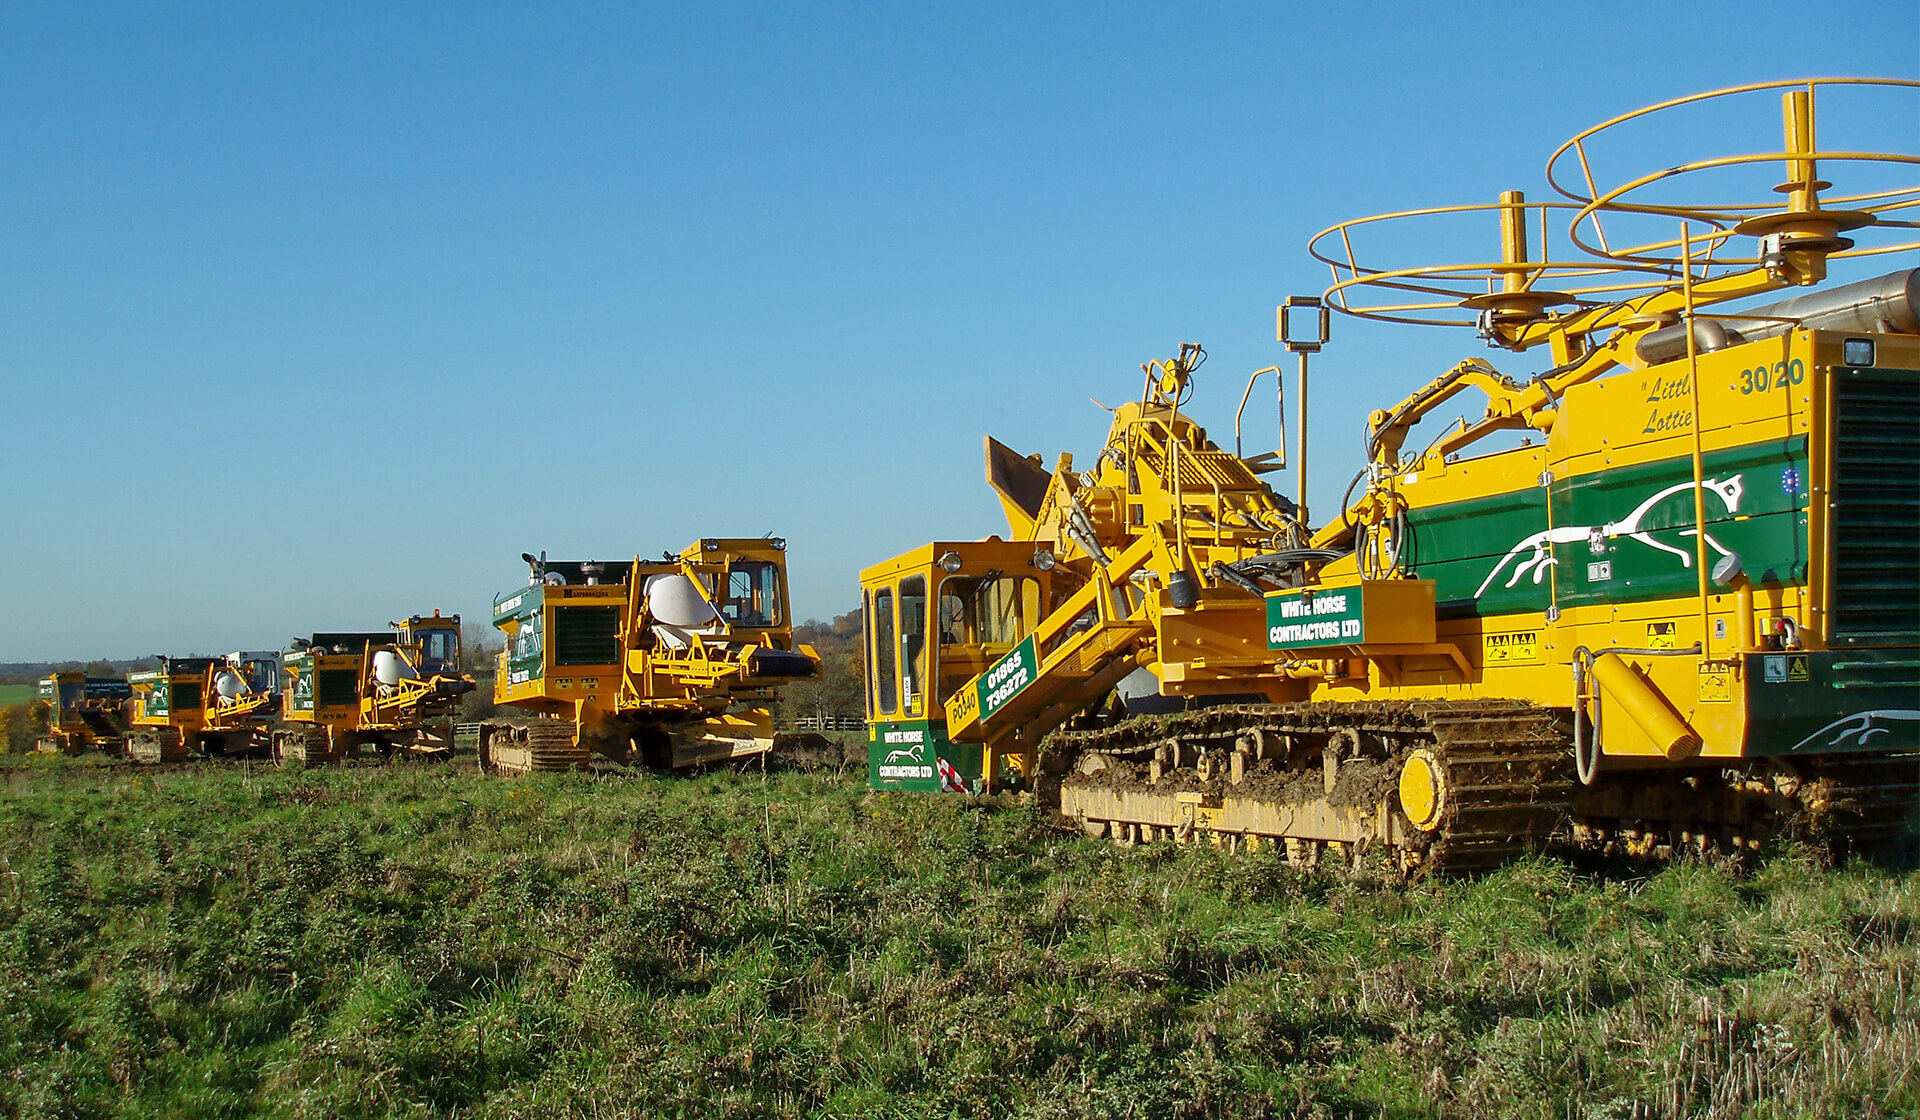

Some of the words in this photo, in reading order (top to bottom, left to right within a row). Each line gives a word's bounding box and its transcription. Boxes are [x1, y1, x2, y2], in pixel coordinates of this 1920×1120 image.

[1740, 358, 1804, 395] 30/20
[1312, 595, 1347, 616] HORSE
[1269, 621, 1340, 644] CONTRACTORS
[1341, 619, 1361, 638] LTD
[988, 650, 1022, 690] 01865
[986, 667, 1028, 711] 736272
[952, 692, 976, 724] PO340
